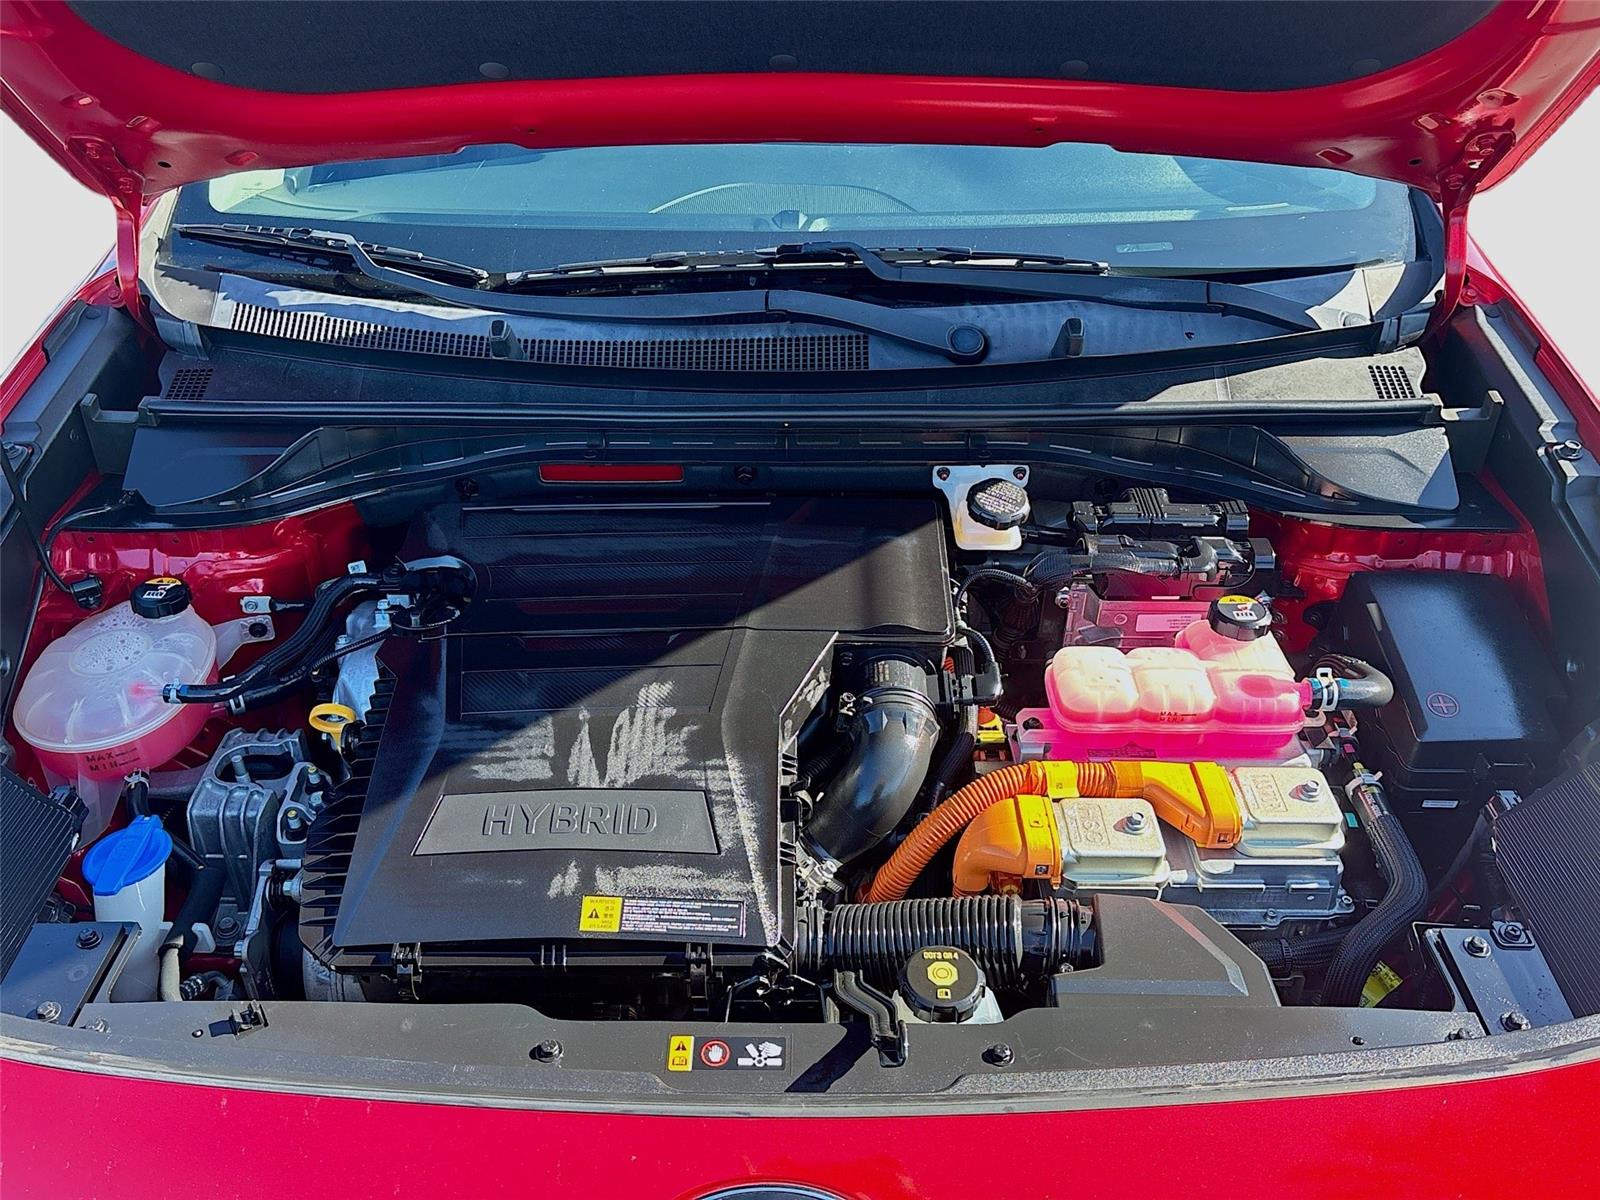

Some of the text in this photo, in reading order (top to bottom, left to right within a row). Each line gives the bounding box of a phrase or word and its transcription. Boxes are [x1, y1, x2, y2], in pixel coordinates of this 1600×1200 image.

[86, 752, 114, 762] MAX
[89, 761, 118, 771] MIN
[482, 802, 657, 836] HYBRID
[923, 951, 942, 960] DOT3
[953, 951, 959, 960] 4
